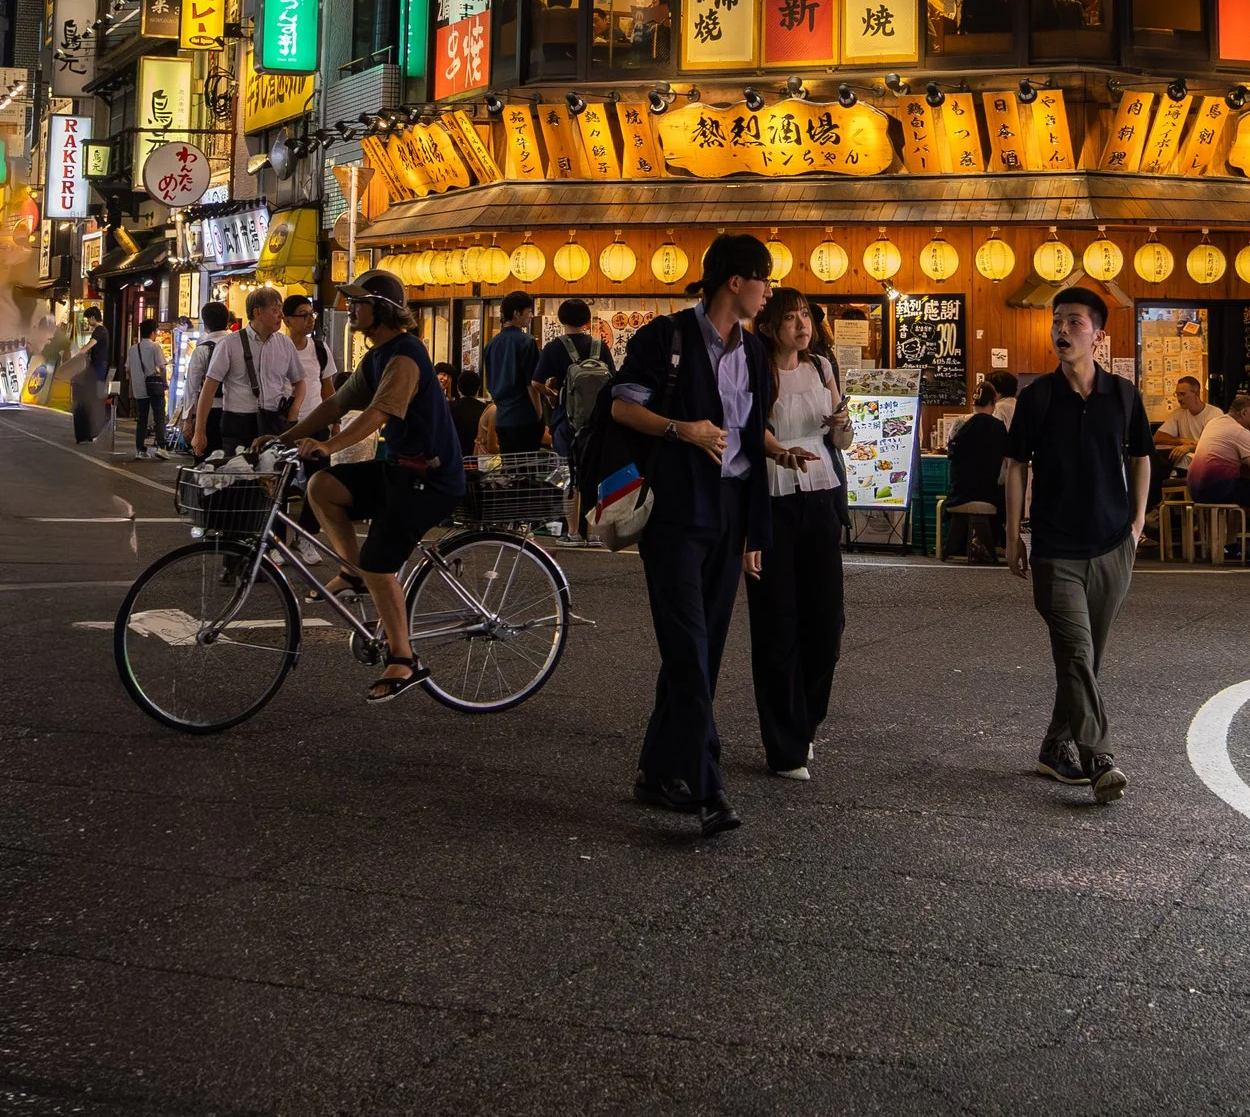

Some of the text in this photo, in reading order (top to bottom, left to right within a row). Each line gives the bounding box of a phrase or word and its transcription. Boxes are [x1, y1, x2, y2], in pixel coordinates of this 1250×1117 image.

[54, 19, 87, 75] 鳥元
[509, 110, 535, 174] 茹で牛タン
[546, 109, 572, 172] 寿司
[625, 109, 653, 173] 焼き鳥
[691, 112, 842, 149] 熱烈酒場
[763, 149, 860, 167] ドンちゃん
[950, 101, 977, 169] もつ煮
[994, 100, 1020, 170] 日本酒
[1041, 95, 1067, 165] やきとん
[1108, 98, 1142, 168] 肉料理
[1190, 102, 1221, 168] 馬刺し
[61, 118, 78, 210] RAKERU
[158, 173, 178, 202] めん
[176, 145, 199, 193] わんたん
